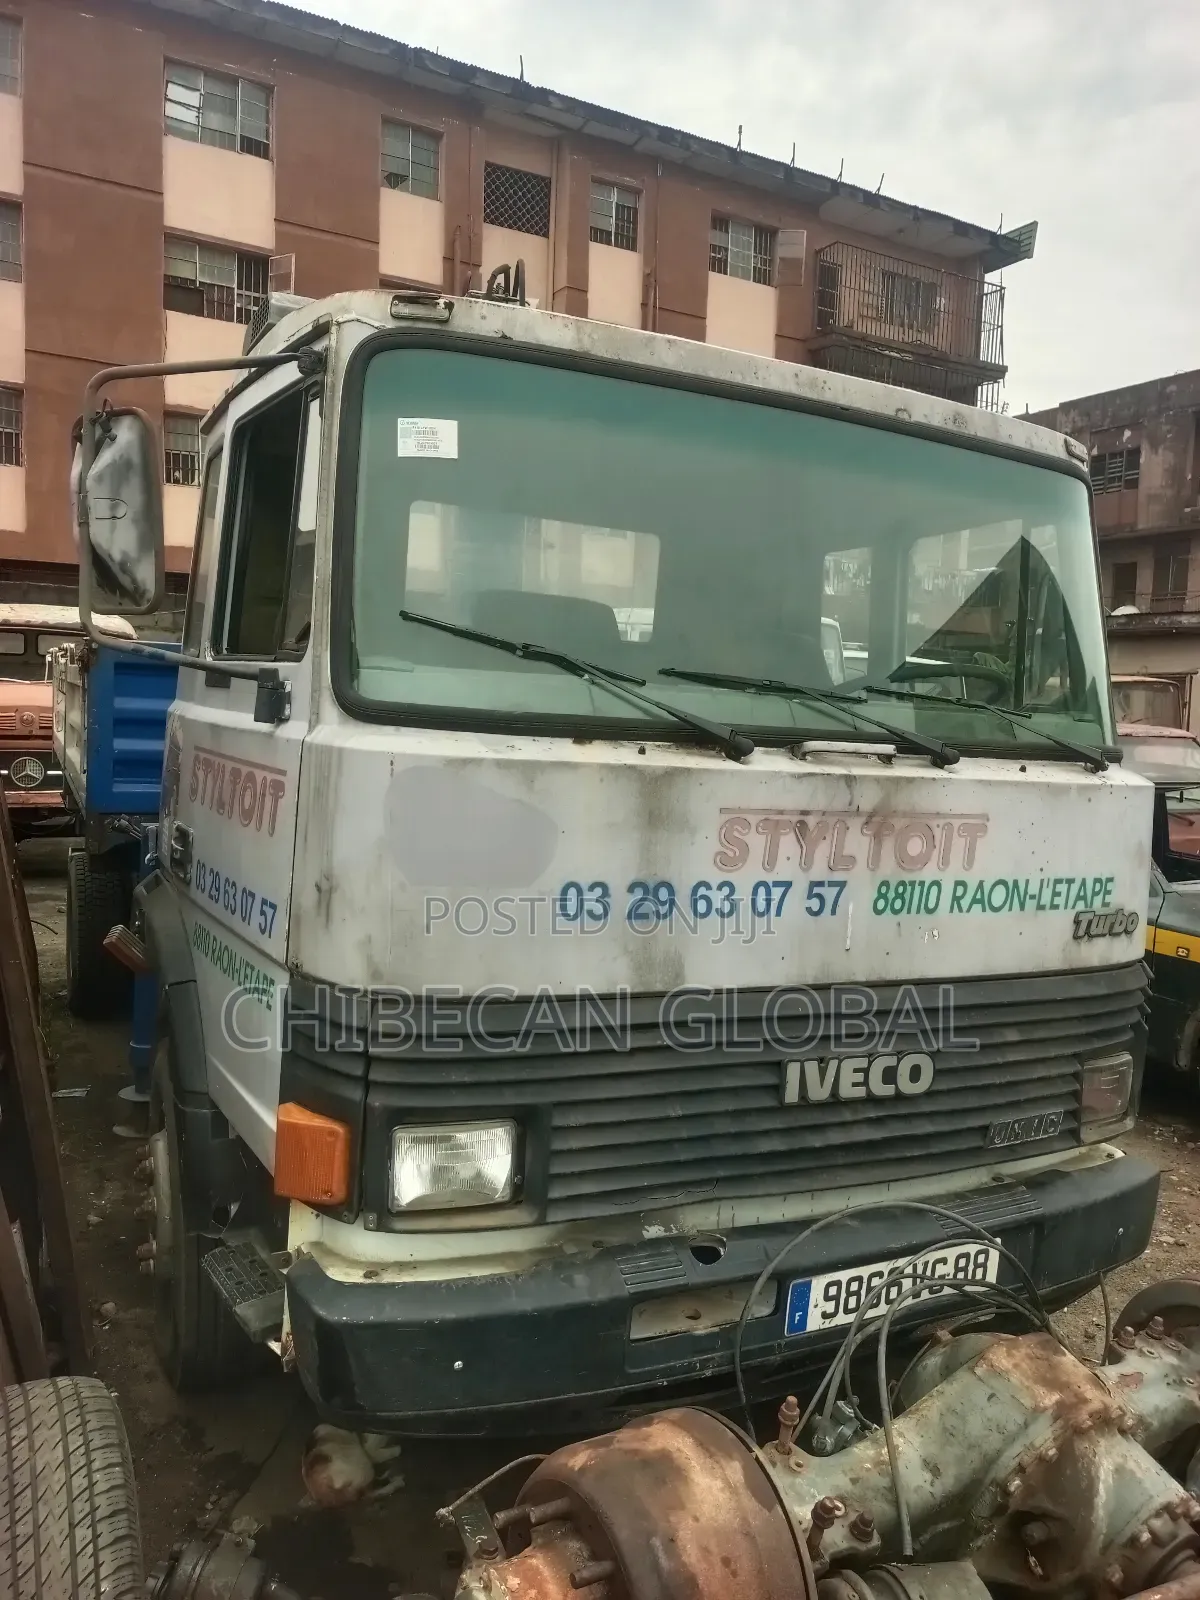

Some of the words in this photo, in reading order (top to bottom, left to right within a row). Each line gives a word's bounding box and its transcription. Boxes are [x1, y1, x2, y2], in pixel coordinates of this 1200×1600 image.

[189, 753, 285, 837] STYLTOIT
[713, 815, 989, 873] STYLTOIT
[195, 859, 206, 894] 03
[208, 867, 221, 904] 29
[223, 876, 237, 916] 63
[240, 886, 256, 927] 07
[258, 897, 278, 939] 57
[560, 880, 611, 922] 03
[626, 880, 676, 920] 29
[690, 880, 737, 920] 63
[751, 880, 793, 918] 07
[805, 881, 848, 917] 57
[872, 880, 942, 916] 88110
[948, 876, 1115, 915] RAON-L'ETAPE
[1073, 908, 1140, 940] Turbo
[783, 1052, 936, 1106] IVECO
[795, 1312, 803, 1325] F
